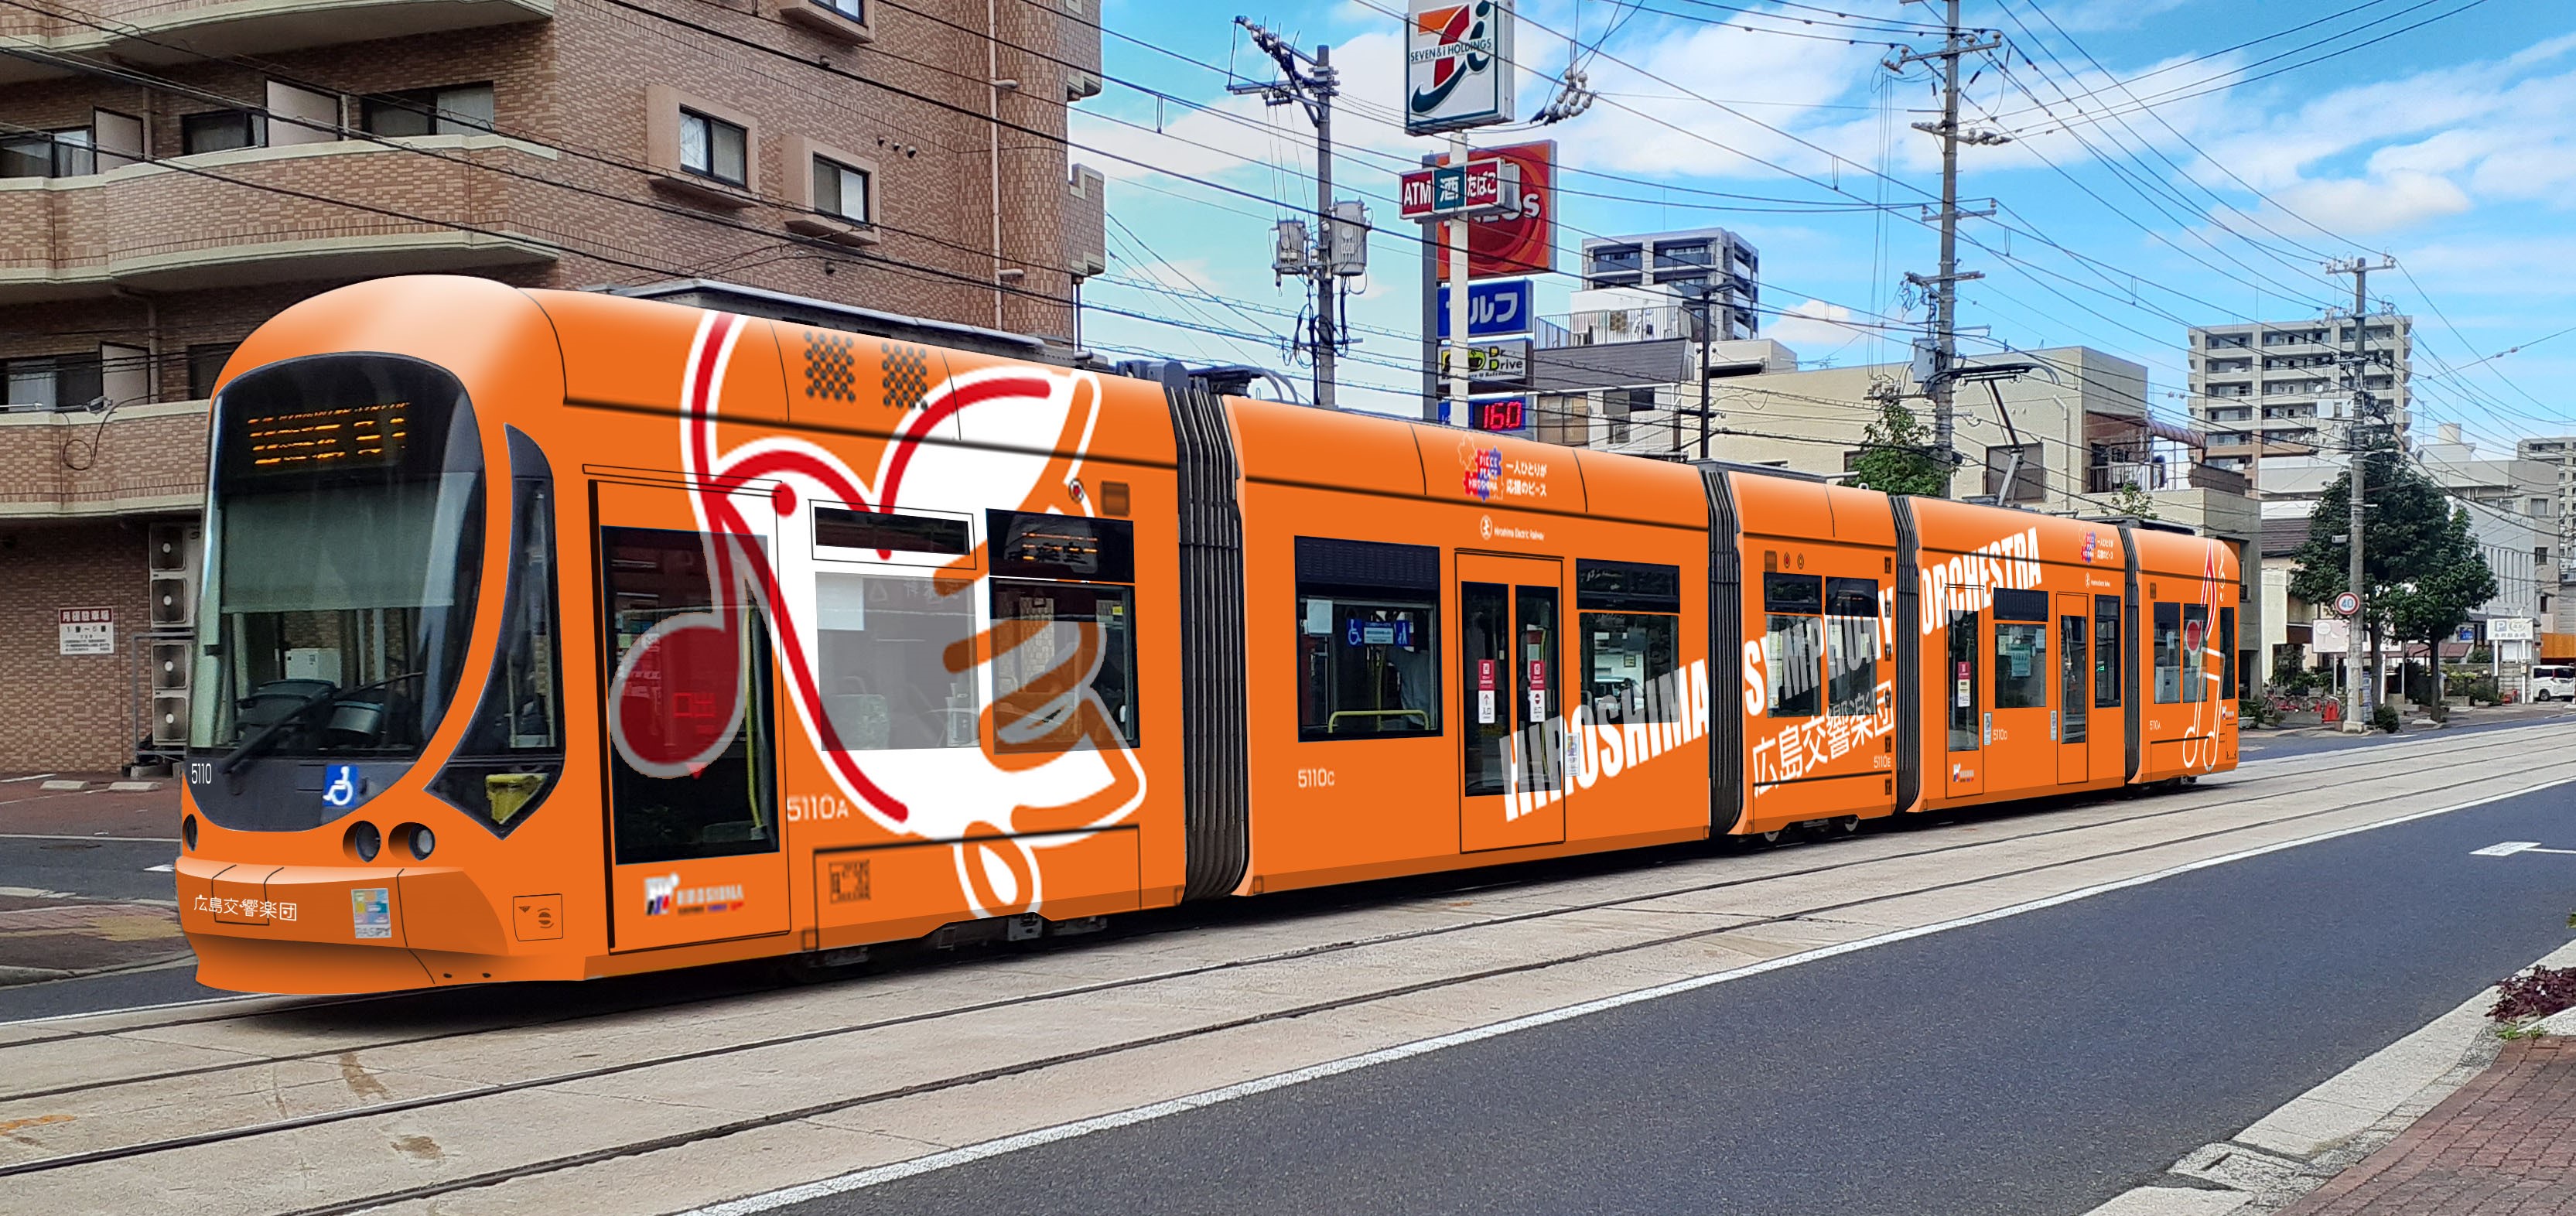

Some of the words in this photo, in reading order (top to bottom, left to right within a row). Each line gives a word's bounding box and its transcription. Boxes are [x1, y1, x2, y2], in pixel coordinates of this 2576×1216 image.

[1447, 38, 1492, 56] HOLDINGS
[1404, 180, 1431, 207] ATM
[1440, 176, 1460, 202] 酒
[1467, 171, 1498, 197] たばこ
[1445, 292, 1518, 324] ルフ
[1489, 345, 1506, 357] Dr
[1489, 358, 1523, 371] Drive
[1483, 401, 1522, 431] 160
[1505, 459, 1547, 478] 一人ひとりが
[2341, 598, 2354, 608] 40
[1499, 658, 1709, 822] HIROSHIMA
[1744, 586, 1894, 716] SYMPHONY
[1922, 526, 2041, 636] ORCHESTRA
[1752, 680, 1895, 799] 広島交響楽団
[191, 763, 212, 784] 5110
[786, 794, 849, 822] 5110A
[193, 893, 298, 921] 広島交響楽団
